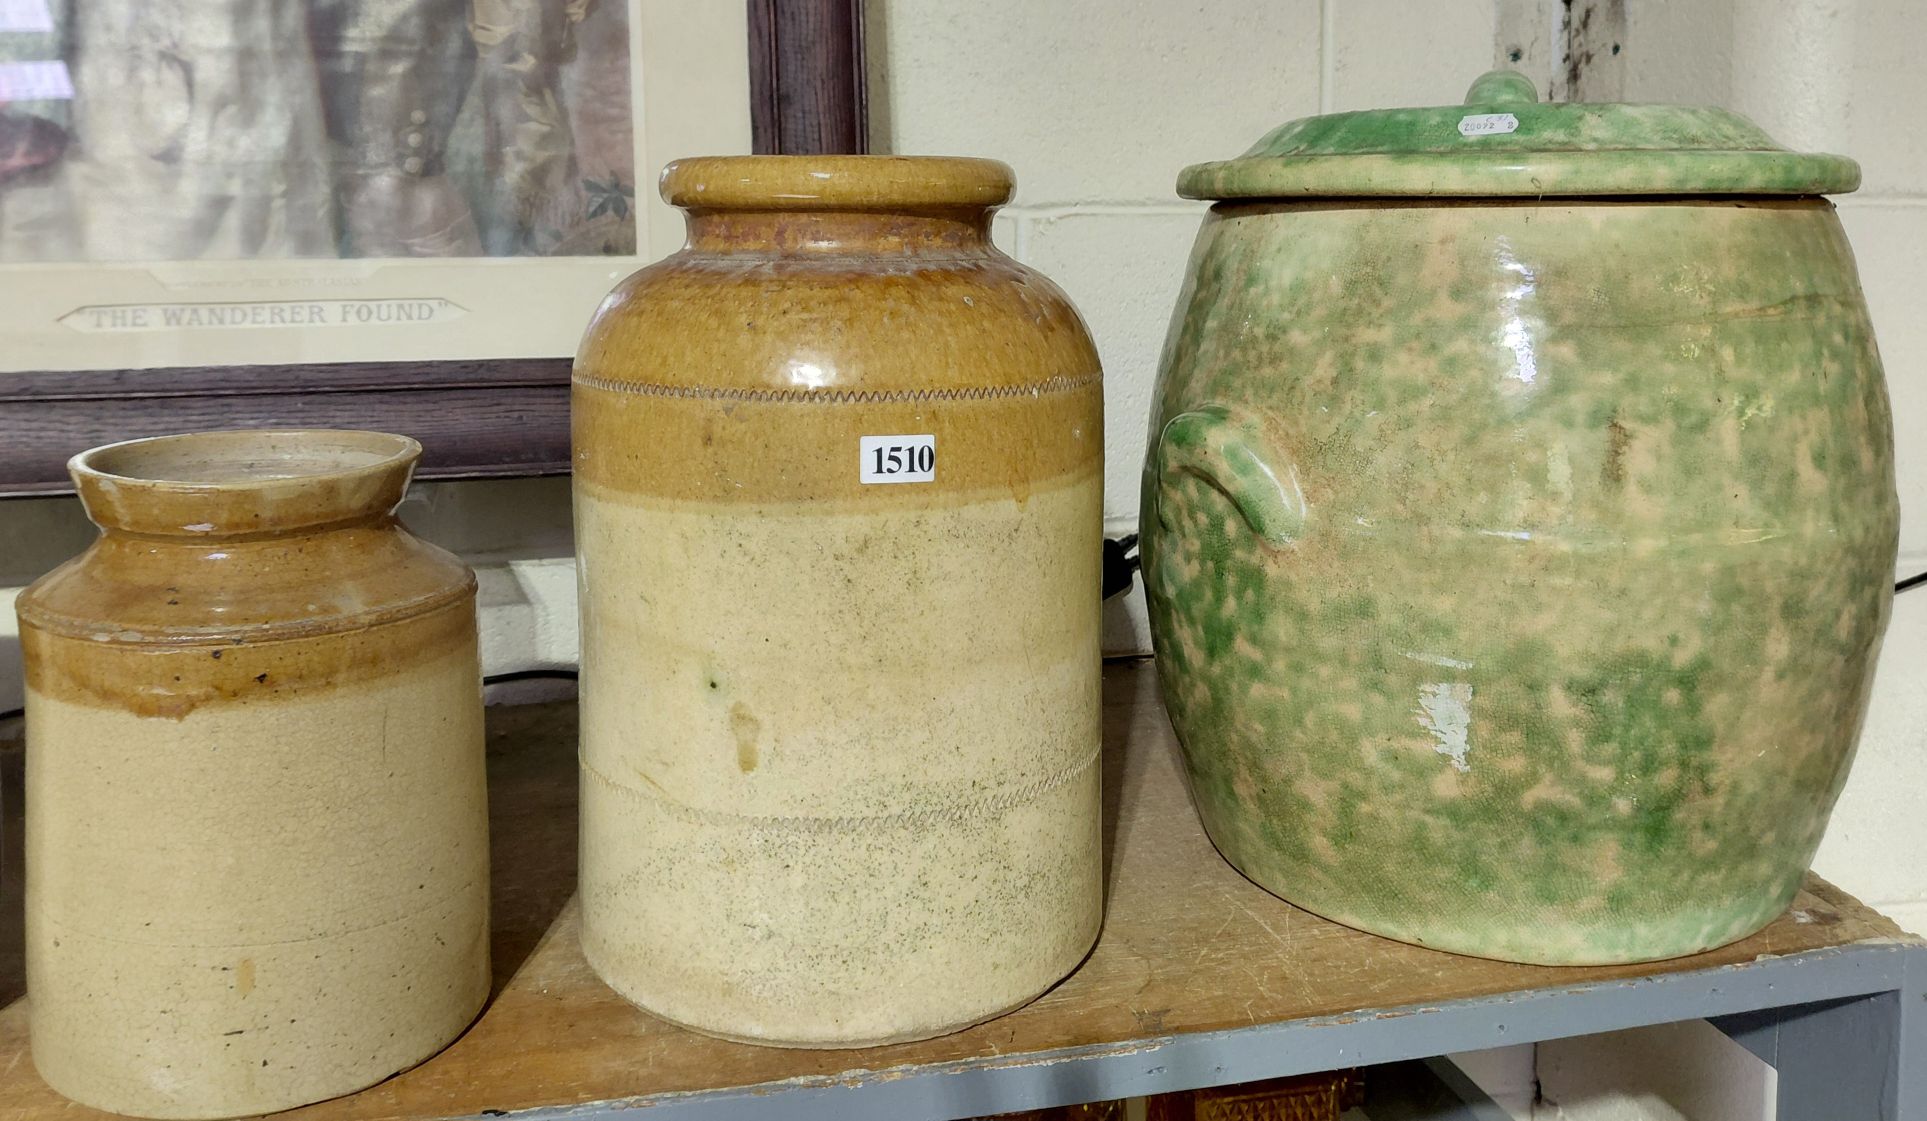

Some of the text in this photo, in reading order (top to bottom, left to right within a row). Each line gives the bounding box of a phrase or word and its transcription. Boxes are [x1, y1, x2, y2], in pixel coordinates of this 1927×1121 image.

[161, 303, 328, 327] WANDERER
[340, 301, 449, 323] FOUND"
[872, 445, 934, 474] 1510
